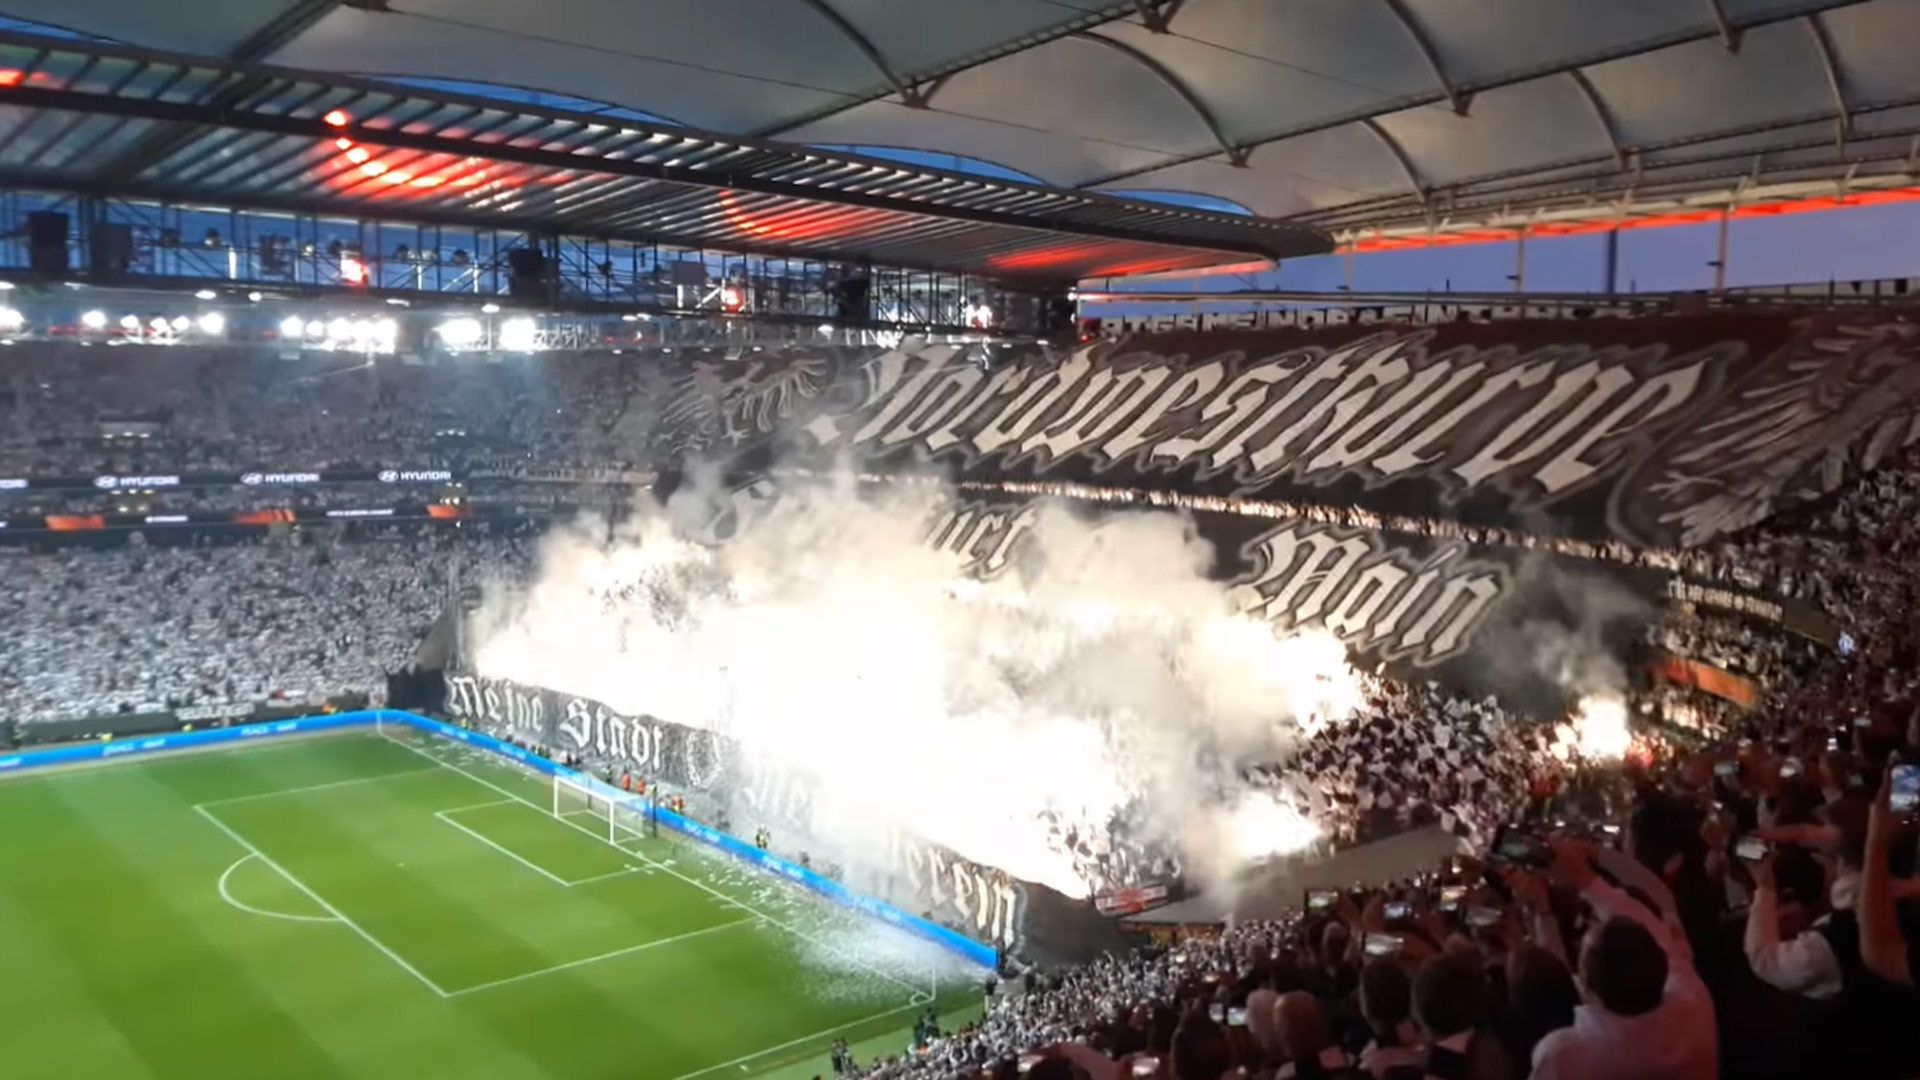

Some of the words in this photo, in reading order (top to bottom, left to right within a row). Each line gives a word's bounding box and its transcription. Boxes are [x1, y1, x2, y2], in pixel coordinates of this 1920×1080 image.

[121, 475, 179, 487] HYUNDAI
[265, 473, 320, 483] HYUNDAI
[400, 471, 452, 481] HYUNDAI
[1222, 529, 1499, 656] Main
[444, 676, 543, 733] Meine
[560, 699, 663, 770] Stadt
